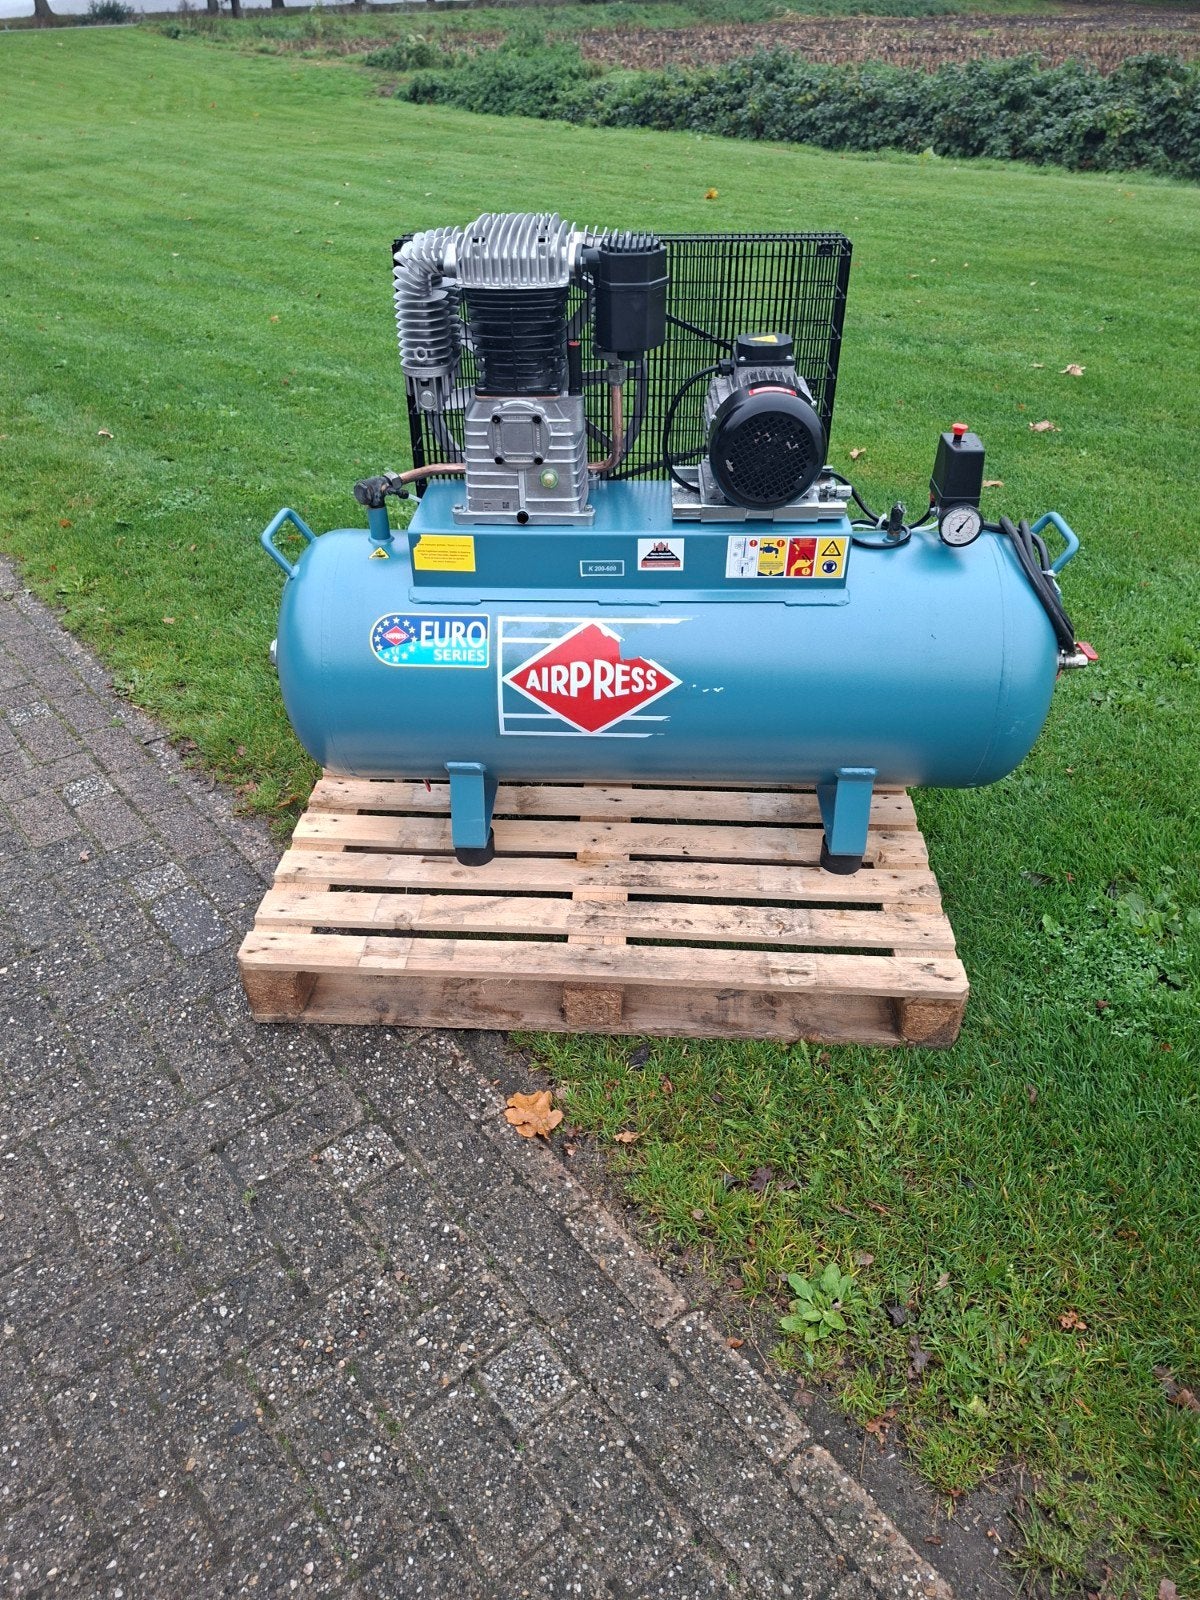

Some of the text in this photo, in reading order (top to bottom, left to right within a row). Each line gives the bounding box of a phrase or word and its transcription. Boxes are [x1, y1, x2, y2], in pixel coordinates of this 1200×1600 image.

[420, 621, 486, 648] EURO
[433, 649, 485, 661] SERIES
[525, 658, 658, 700] AIRPRESS
